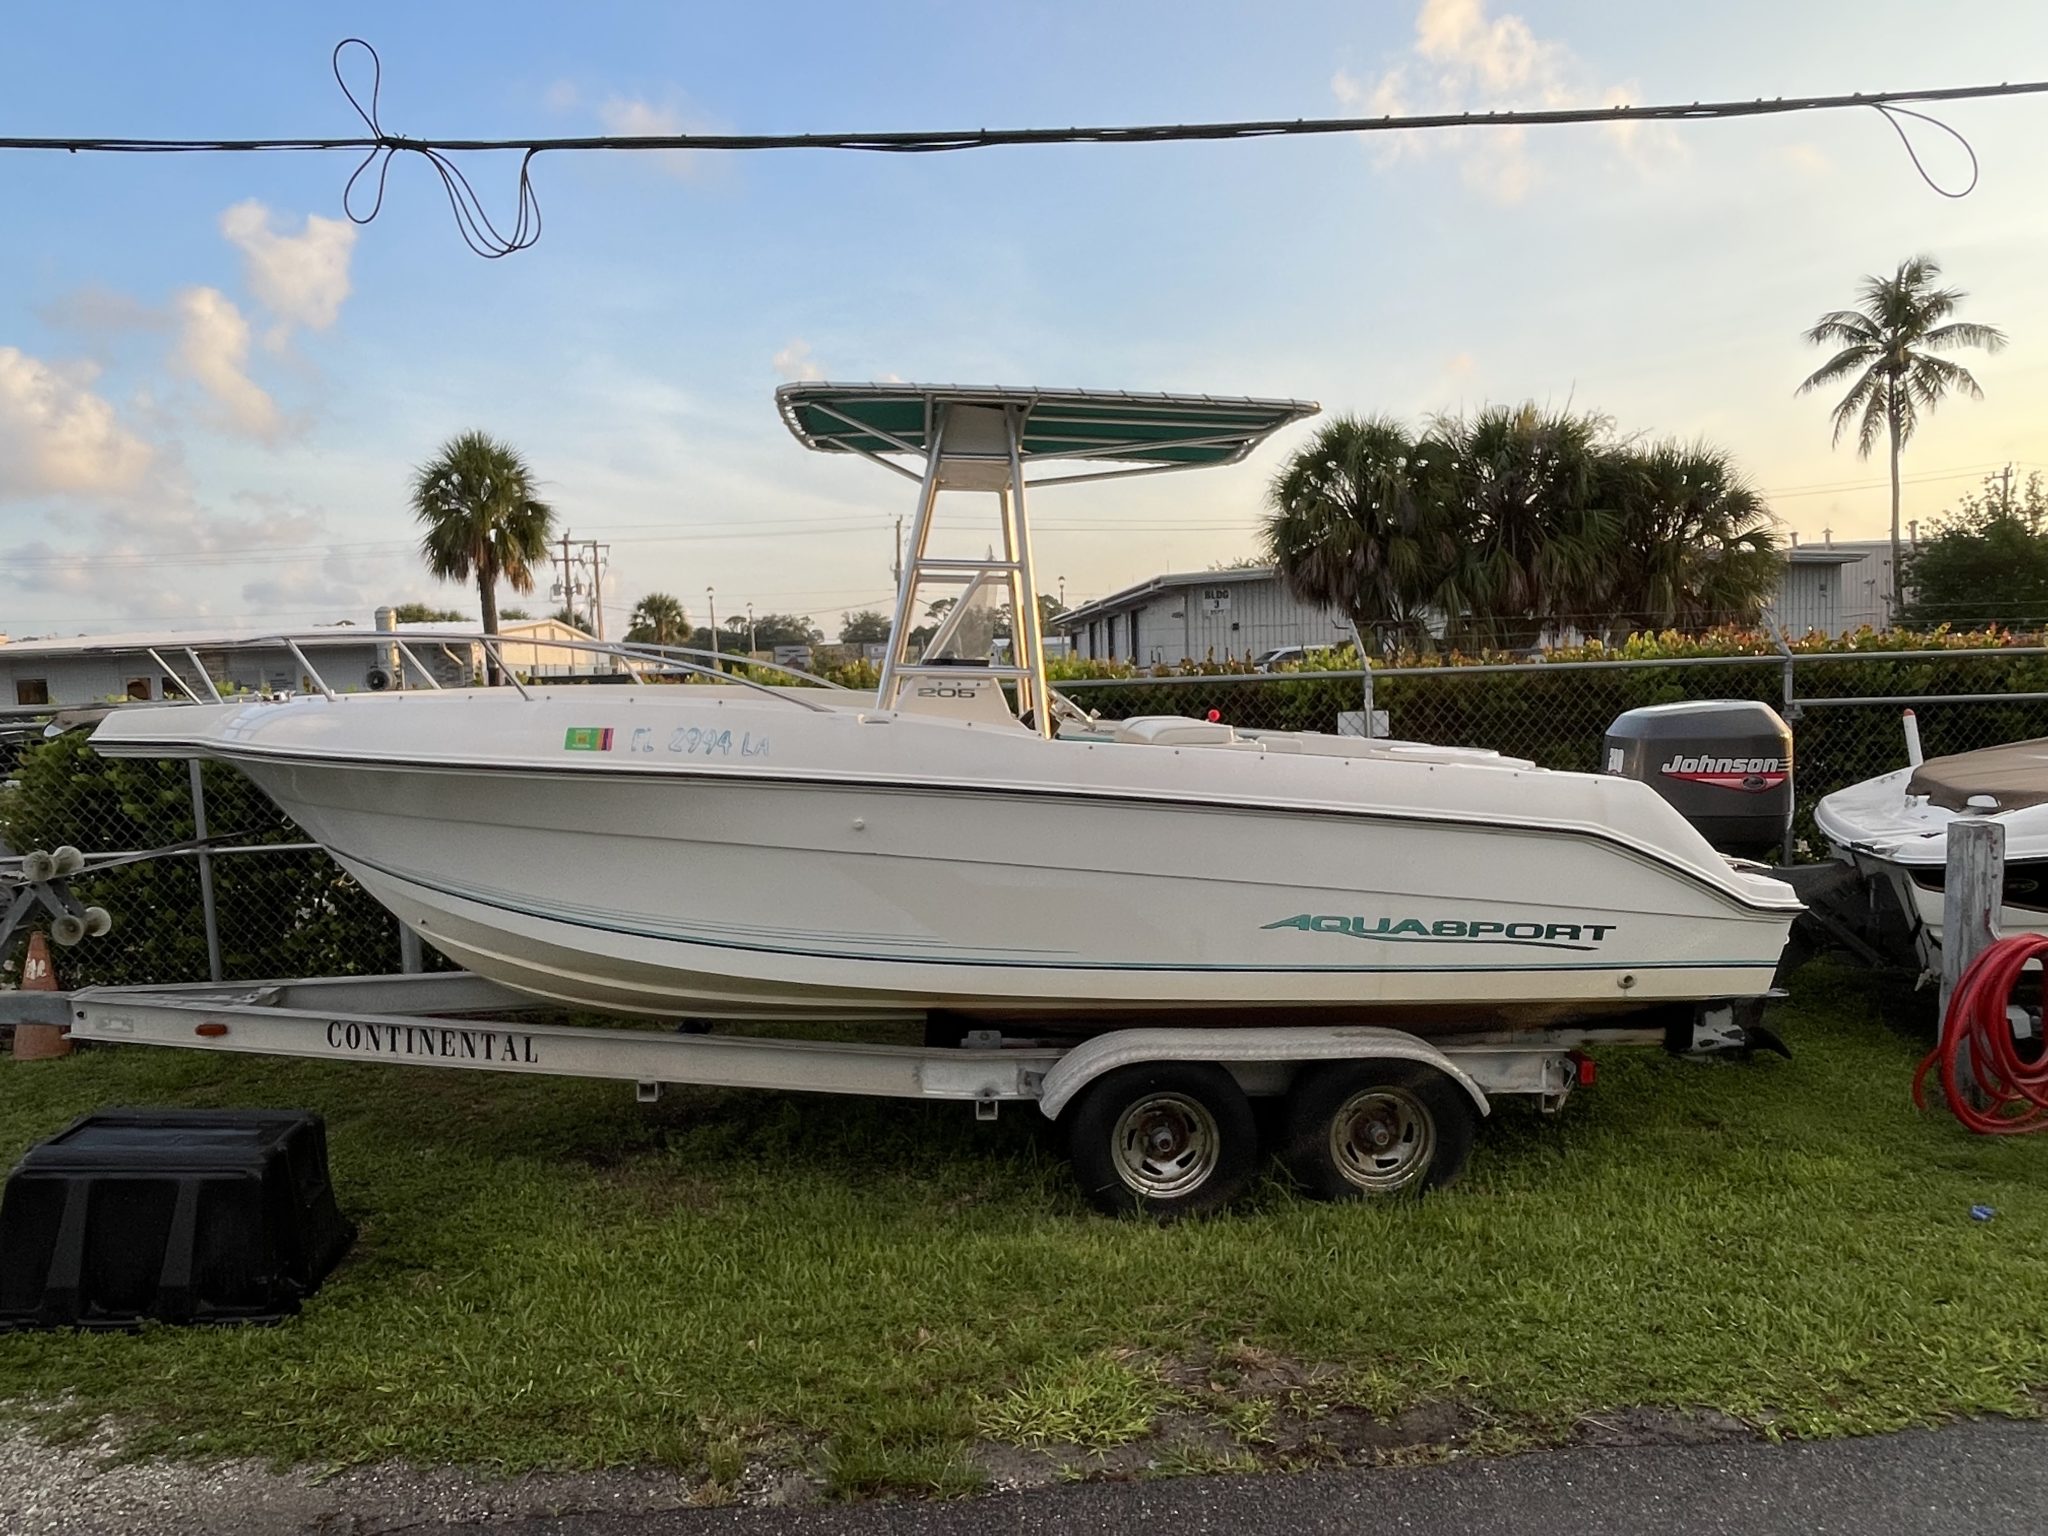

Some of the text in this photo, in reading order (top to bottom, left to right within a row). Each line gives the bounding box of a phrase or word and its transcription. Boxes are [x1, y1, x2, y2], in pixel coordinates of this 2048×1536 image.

[1205, 590, 1229, 599] BLDG
[917, 687, 976, 698] 205
[1661, 754, 1779, 774] Johnson
[326, 1020, 539, 1064] CONTINENTAL
